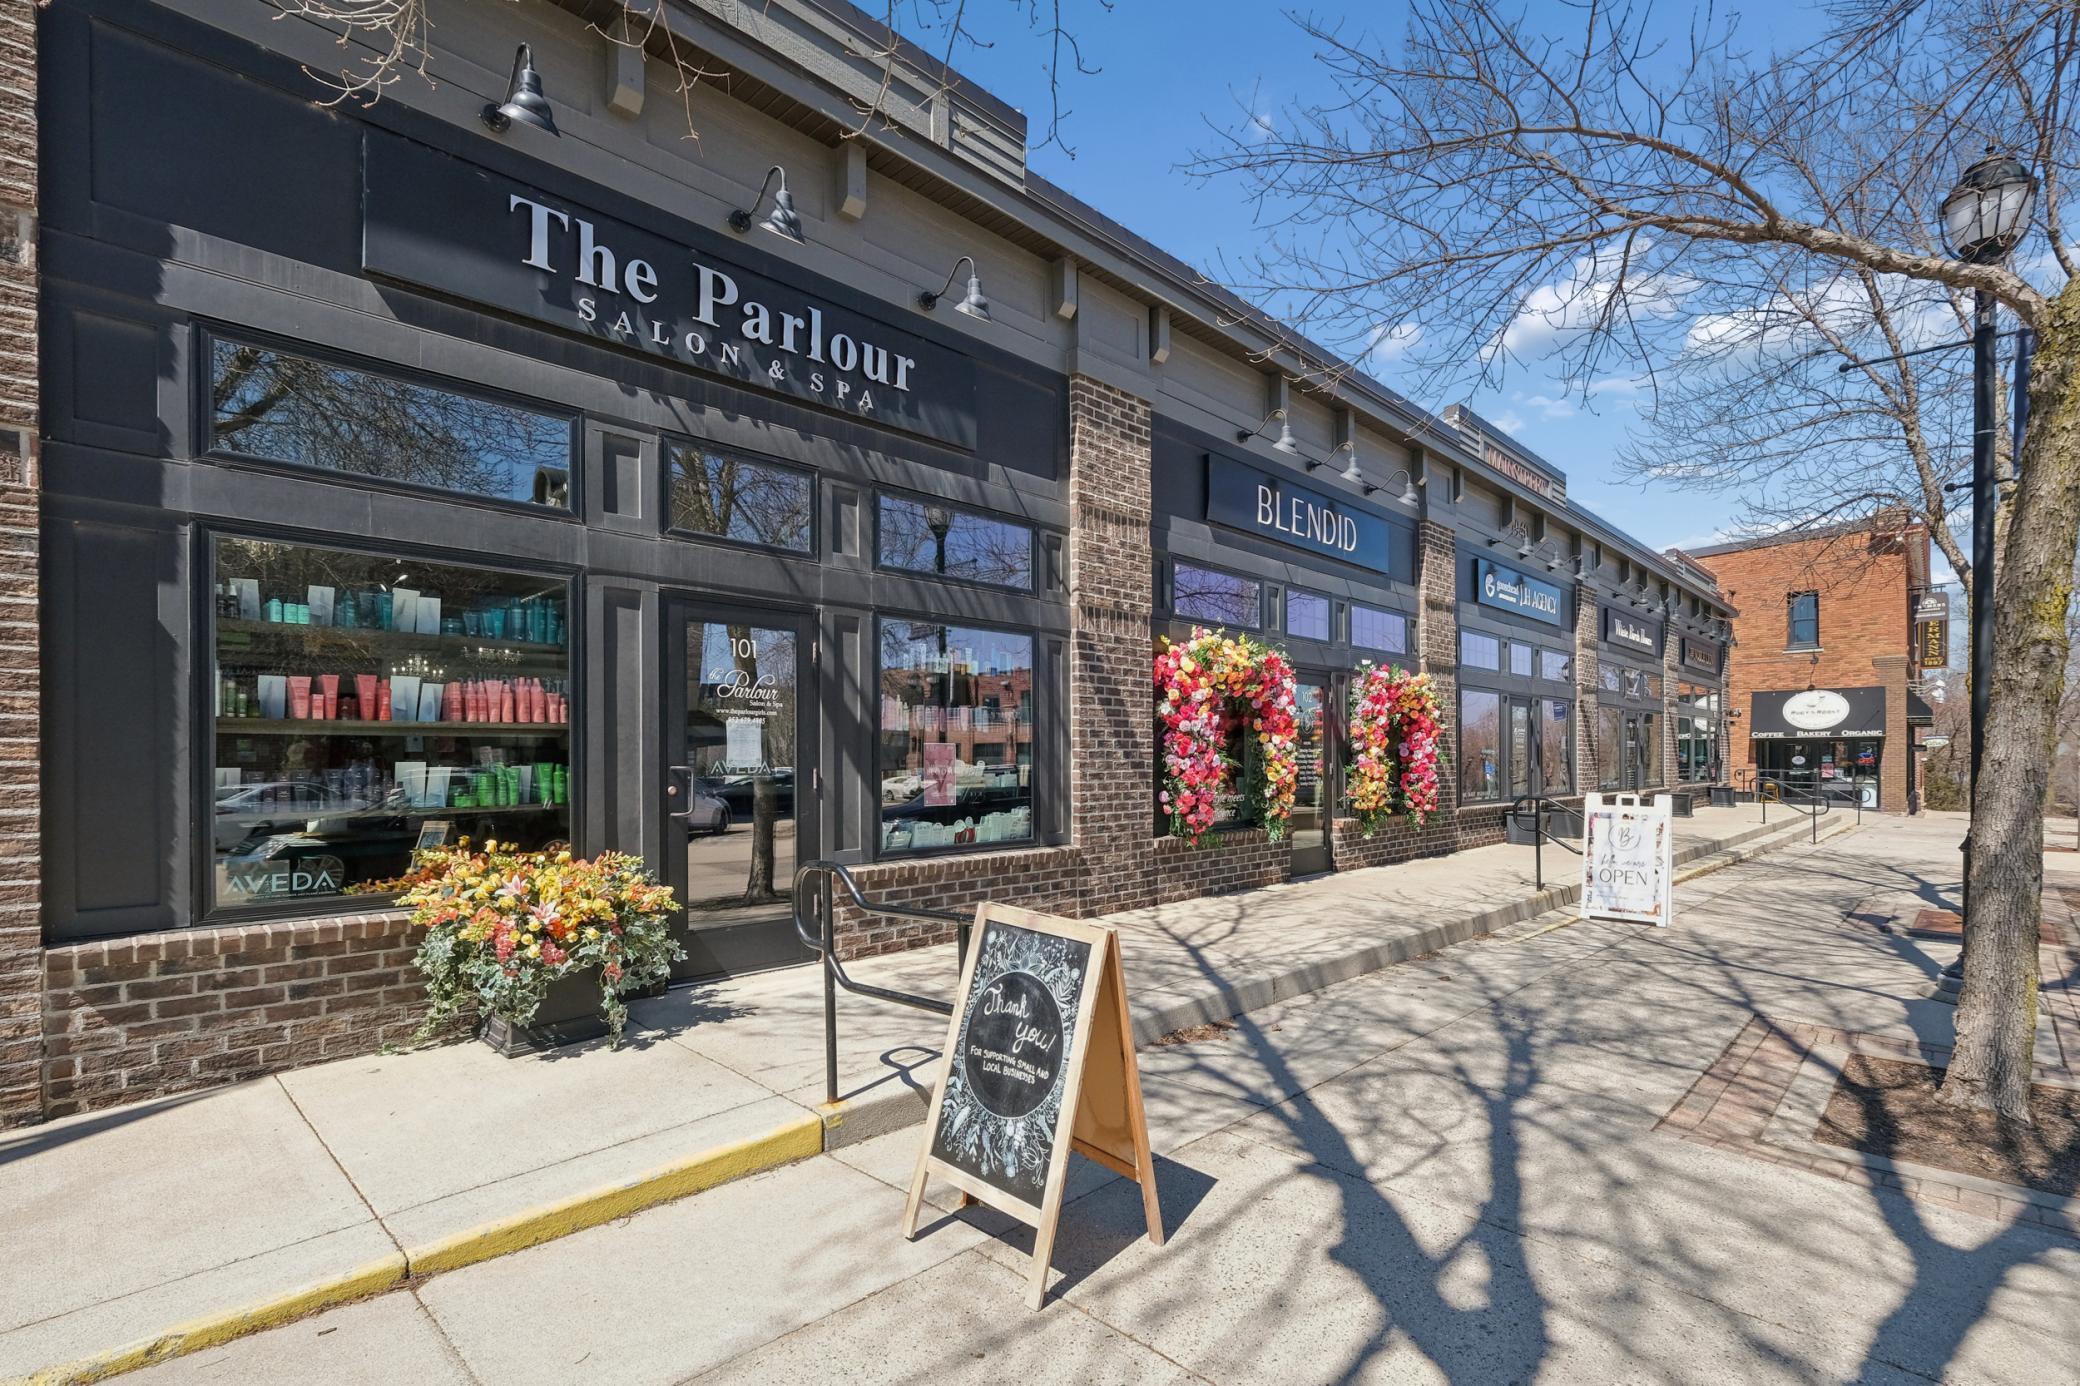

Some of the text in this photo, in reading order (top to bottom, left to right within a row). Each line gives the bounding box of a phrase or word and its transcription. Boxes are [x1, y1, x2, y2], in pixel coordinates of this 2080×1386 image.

[509, 193, 915, 392] The Parlour
[577, 297, 873, 410] SALON & SPA
[1257, 484, 1357, 552] BLENDID
[1531, 590, 1558, 614] AGENCY
[730, 637, 757, 659] 101
[716, 669, 779, 701] Parlour
[1302, 691, 1313, 703] 102
[1841, 729, 1883, 737] ORGANIC
[223, 869, 336, 896] AVEDA
[1599, 867, 1648, 887] OPEN
[983, 983, 1030, 1018] Thank
[1012, 1021, 1057, 1054] you!
[970, 1044, 1050, 1080] FOR SUPPORTING SMALL AND
[982, 1060, 1036, 1085] LOCAL BUSINESSES
